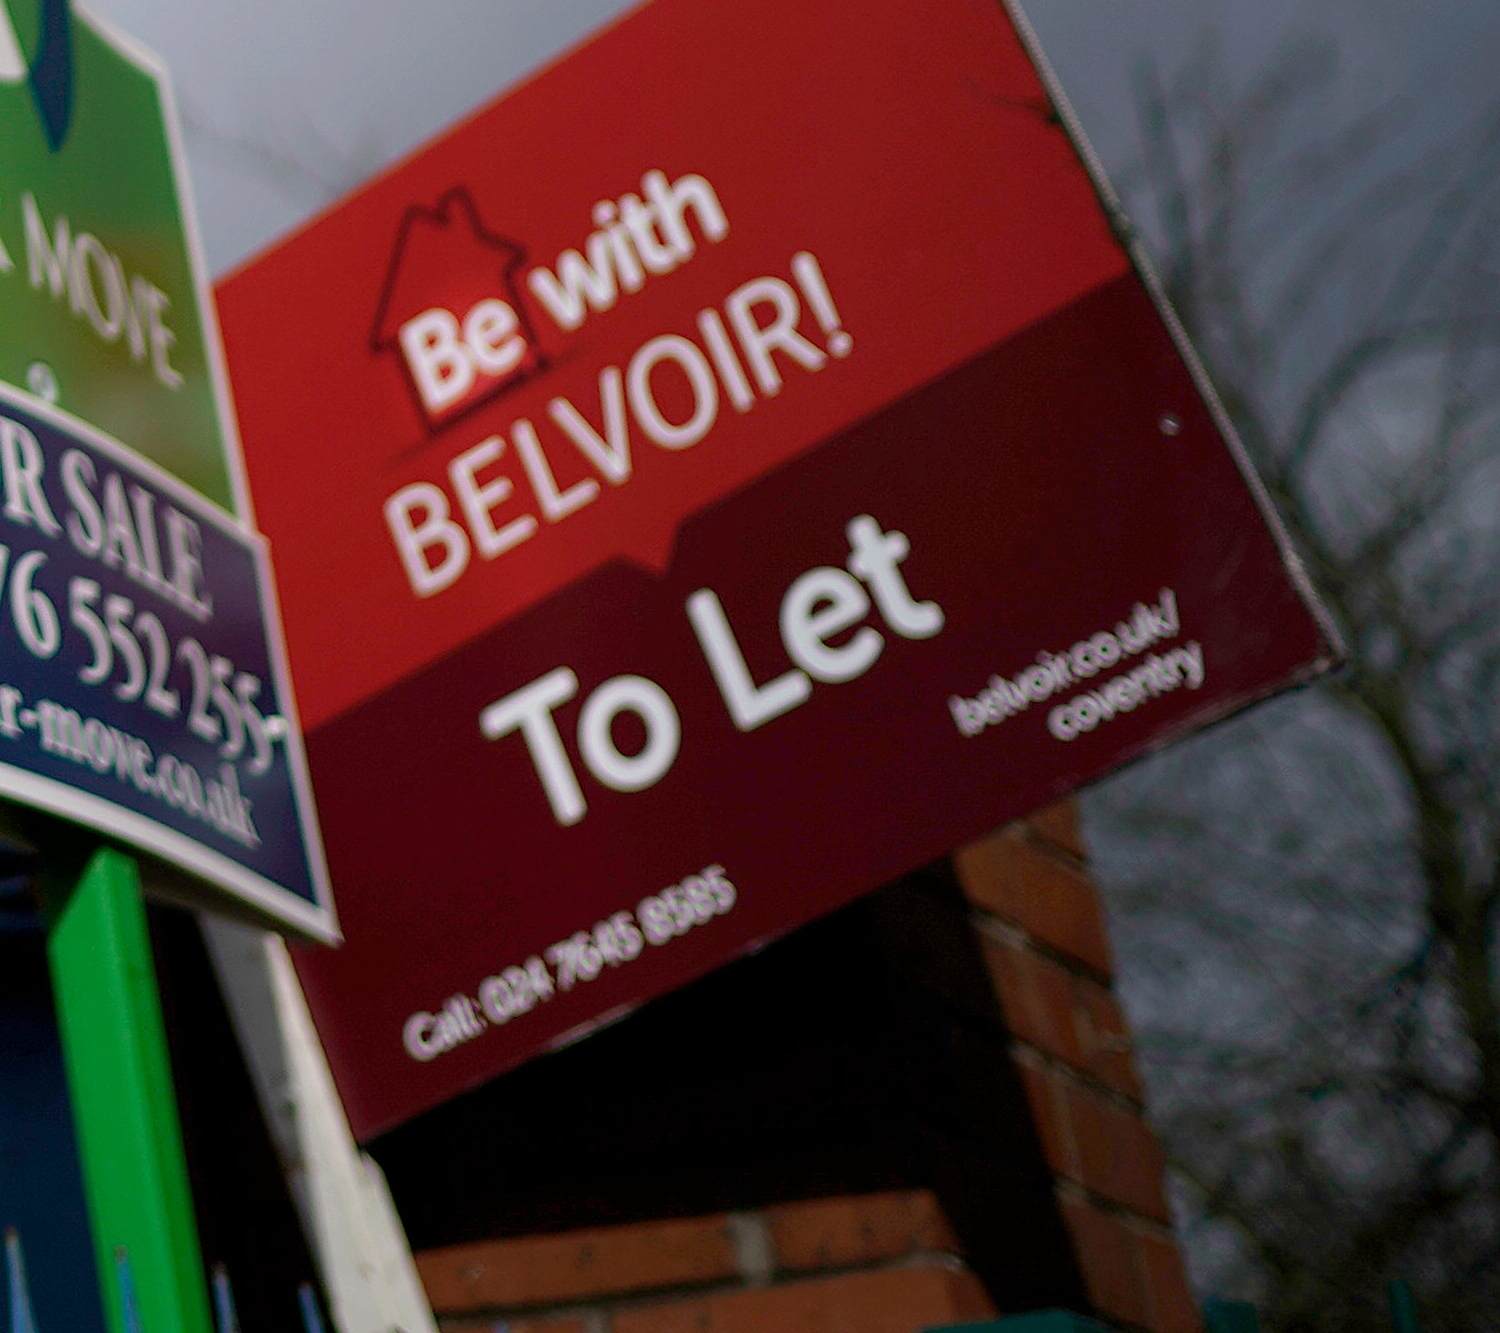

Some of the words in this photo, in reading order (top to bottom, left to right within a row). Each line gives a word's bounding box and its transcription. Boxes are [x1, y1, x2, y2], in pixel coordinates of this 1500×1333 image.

[22, 190, 184, 391] MOVE
[399, 291, 524, 413] Be
[530, 169, 730, 331] with
[383, 250, 853, 597] BELVOIR!
[62, 448, 212, 622] SALE
[68, 576, 181, 717] 552
[177, 637, 273, 777] 255
[479, 667, 682, 827] To
[687, 514, 945, 731] Let
[1047, 639, 1205, 742] coventry
[478, 955, 554, 1026] 024
